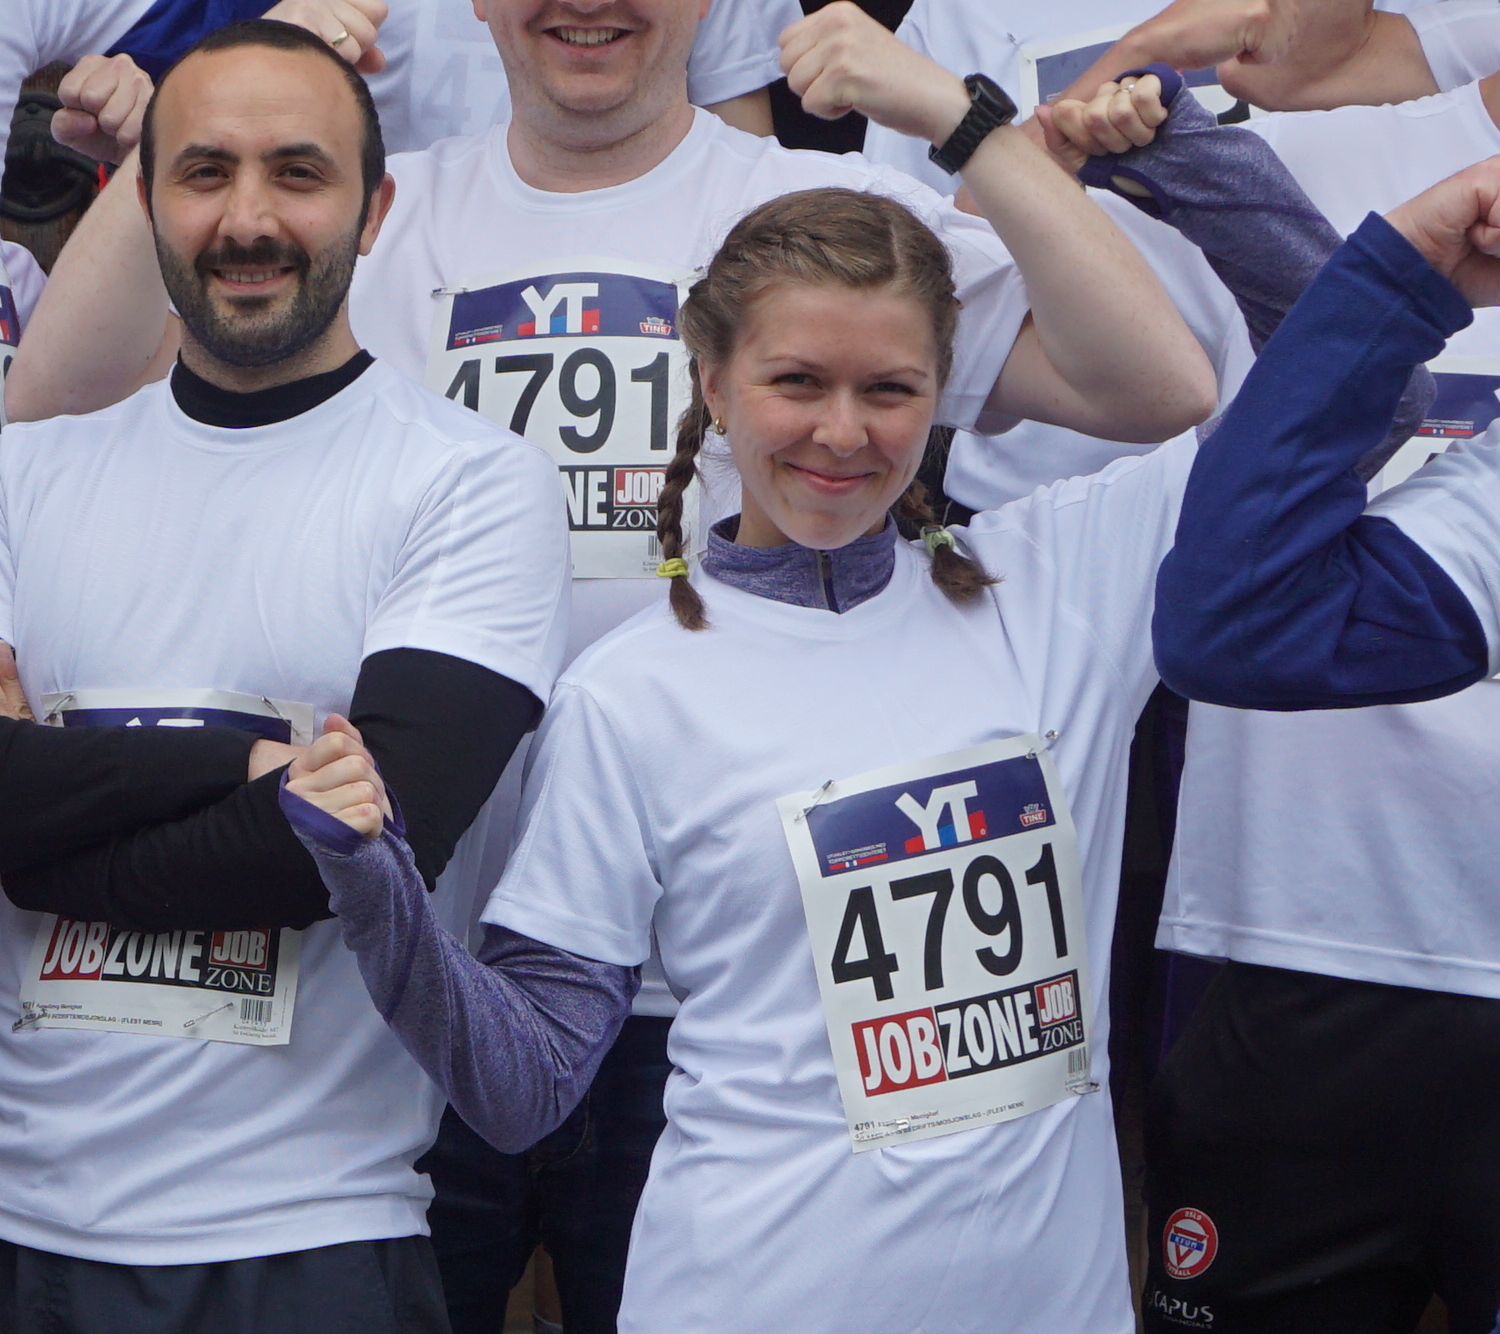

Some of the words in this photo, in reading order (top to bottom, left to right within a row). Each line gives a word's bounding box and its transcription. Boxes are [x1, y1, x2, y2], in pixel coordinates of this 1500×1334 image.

[520, 283, 599, 334] YT
[894, 779, 978, 851] YT
[1023, 813, 1045, 825] TINE
[831, 843, 1068, 1002] 4791
[213, 930, 266, 965] JOB
[204, 967, 272, 994] ZONE
[1040, 982, 1074, 1022] JOB
[1042, 1020, 1083, 1052] ZONE
[1174, 1236, 1198, 1249] KFUM
